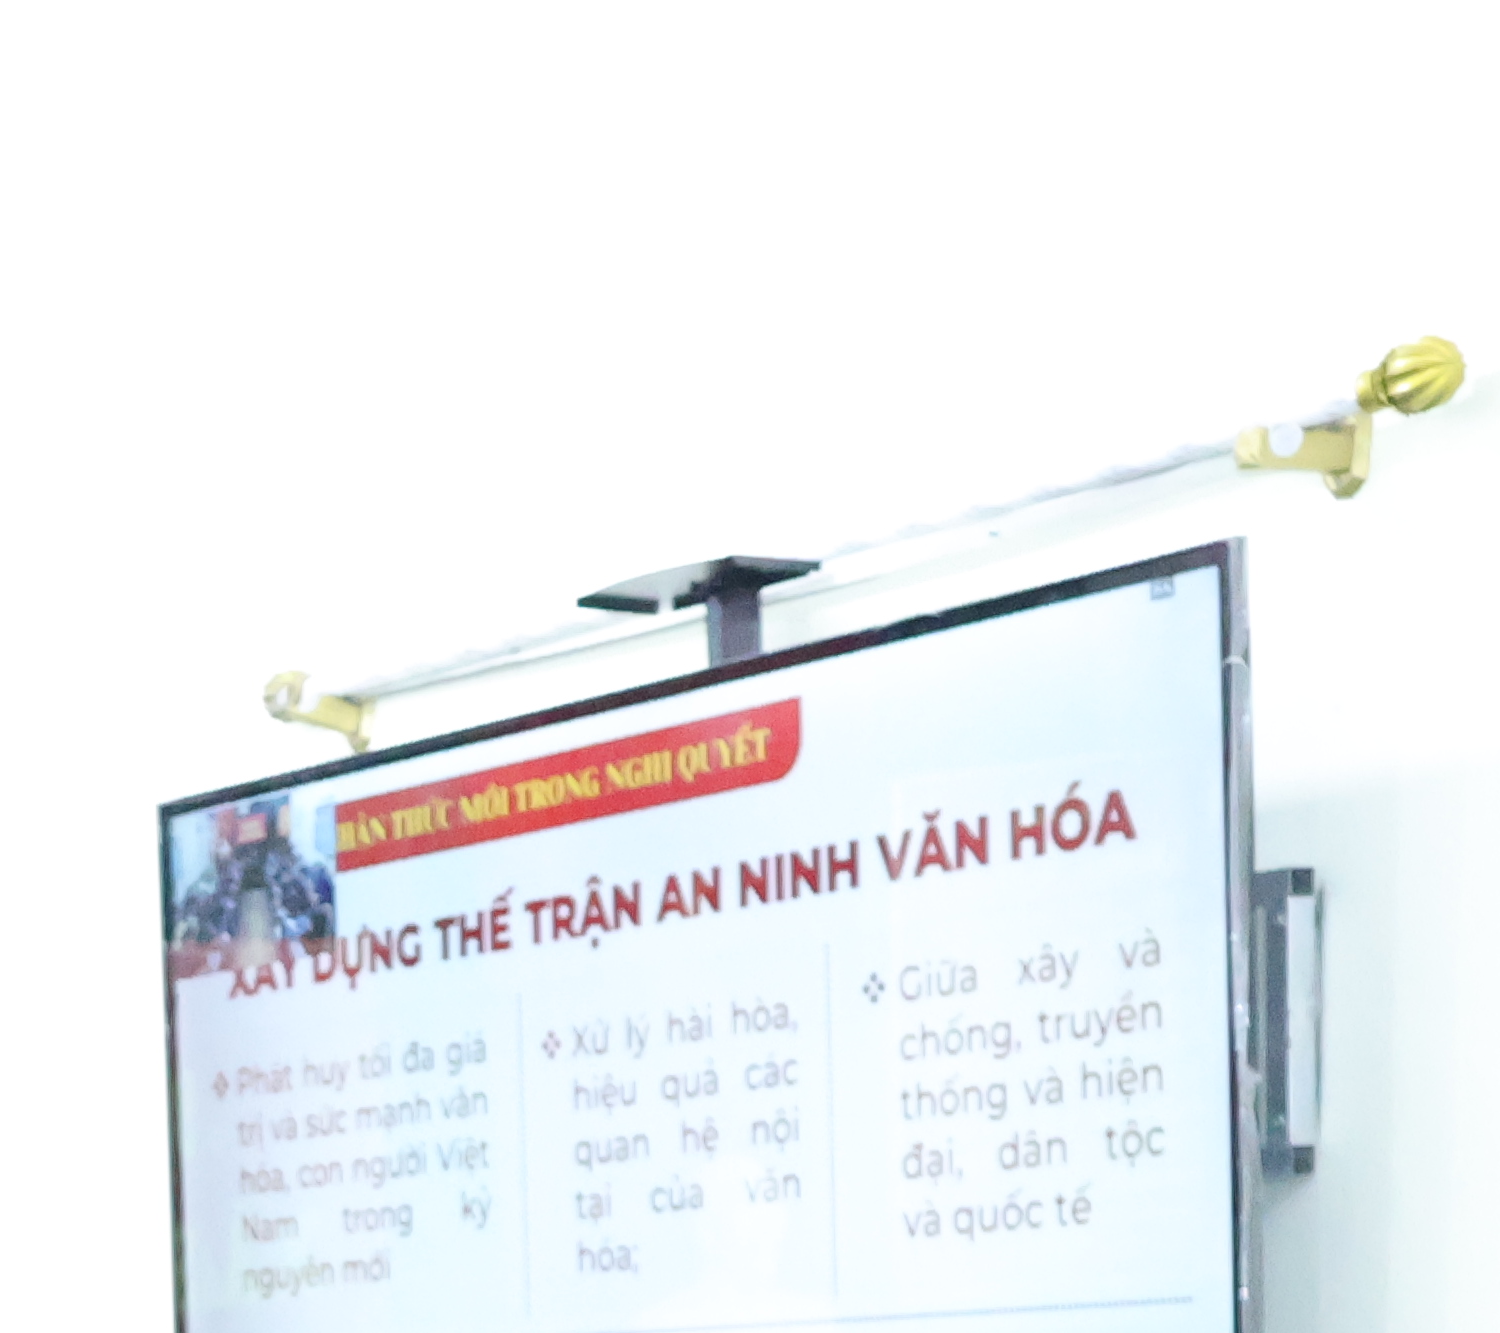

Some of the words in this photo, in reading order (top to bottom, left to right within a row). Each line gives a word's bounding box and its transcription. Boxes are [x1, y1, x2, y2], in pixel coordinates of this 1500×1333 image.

[436, 887, 513, 961] THẾ
[524, 875, 641, 948] TRẬN
[656, 866, 722, 923] AN
[740, 840, 859, 907] NINH
[877, 809, 989, 881] VĂN
[1011, 780, 1138, 861] HÓA
[1018, 942, 1079, 990] xây
[1118, 927, 1162, 969] và
[1023, 1065, 1065, 1105] và
[1081, 1056, 1164, 1105] hiện
[575, 1133, 650, 1172] quan
[998, 1129, 1068, 1171] dân
[1105, 1119, 1165, 1168] tộc
[903, 1199, 941, 1238] và
